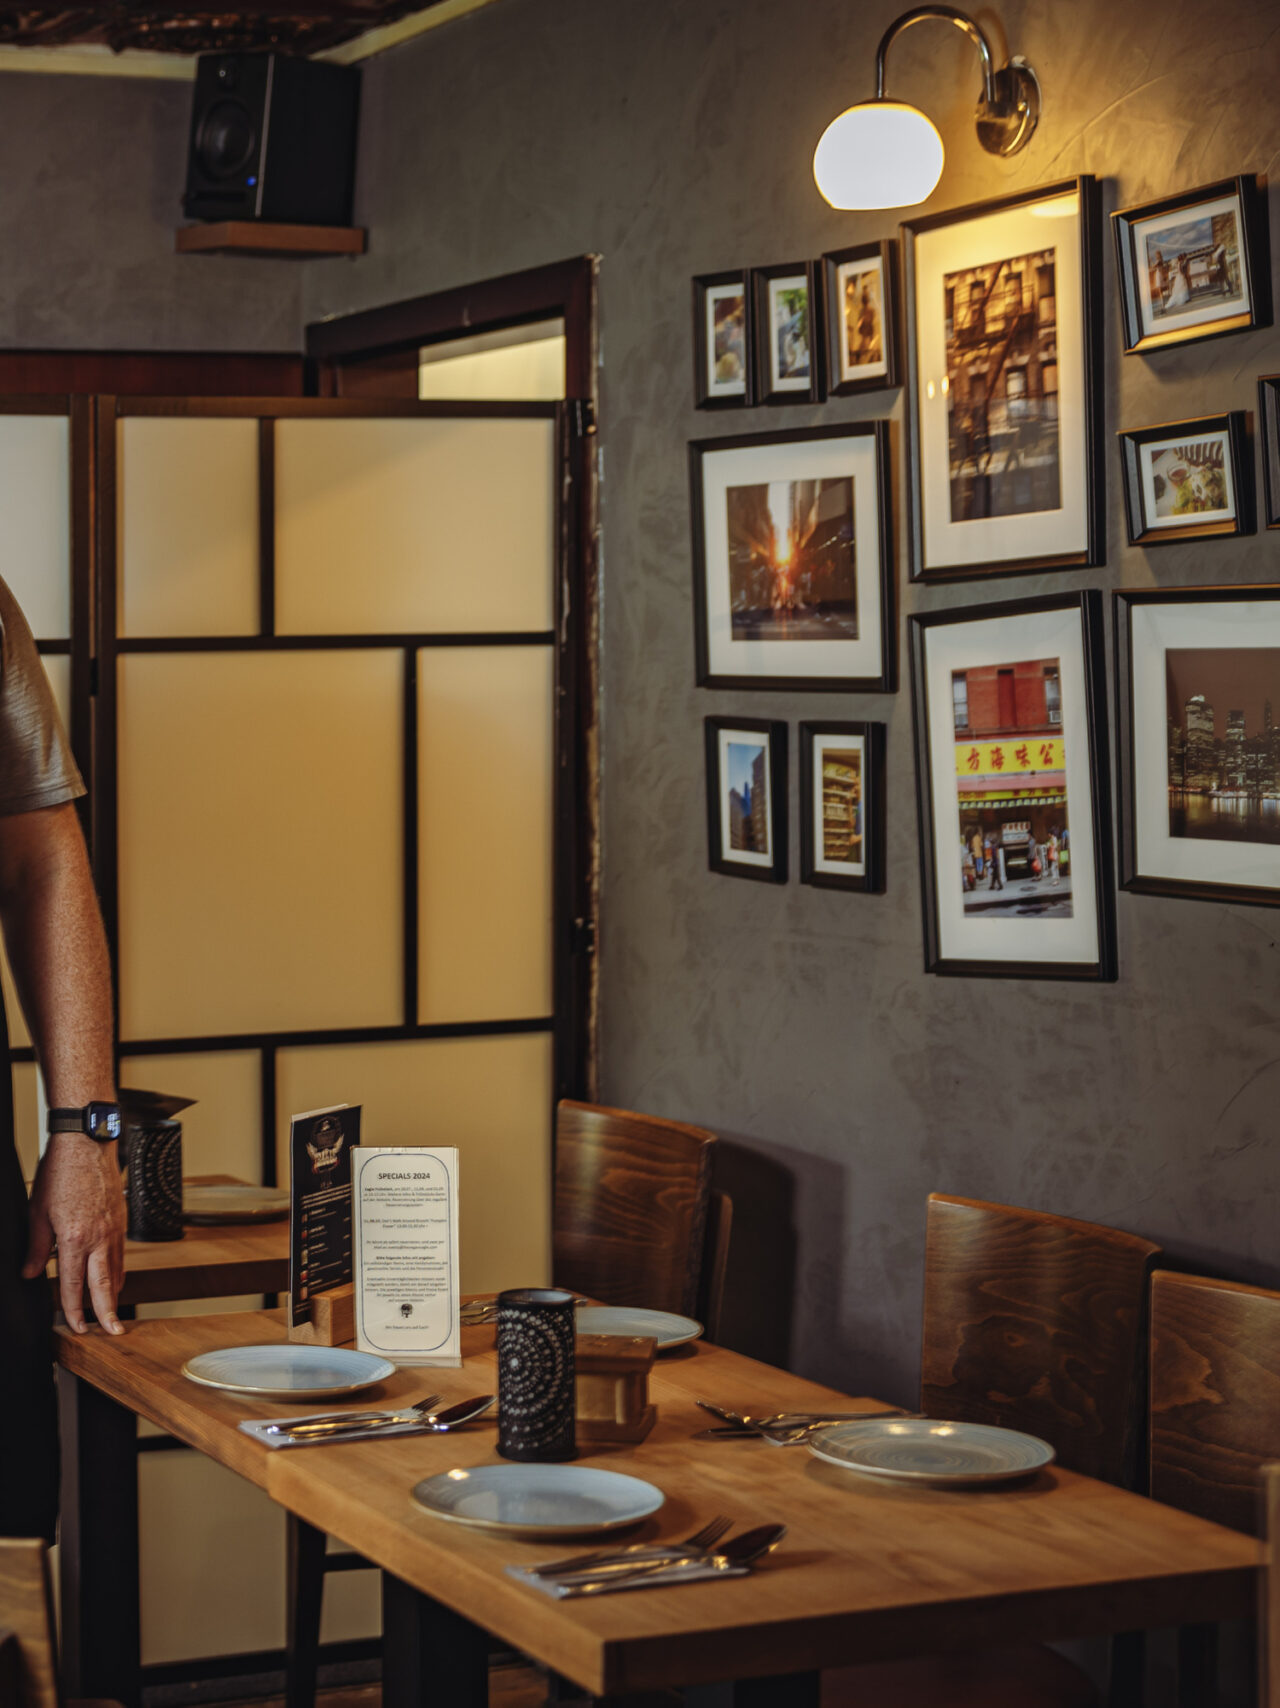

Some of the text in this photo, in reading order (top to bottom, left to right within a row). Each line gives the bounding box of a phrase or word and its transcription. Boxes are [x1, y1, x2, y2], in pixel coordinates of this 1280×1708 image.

[956, 743, 1065, 771] 方海味公
[378, 1172, 431, 1180] SPECIALS 2024
